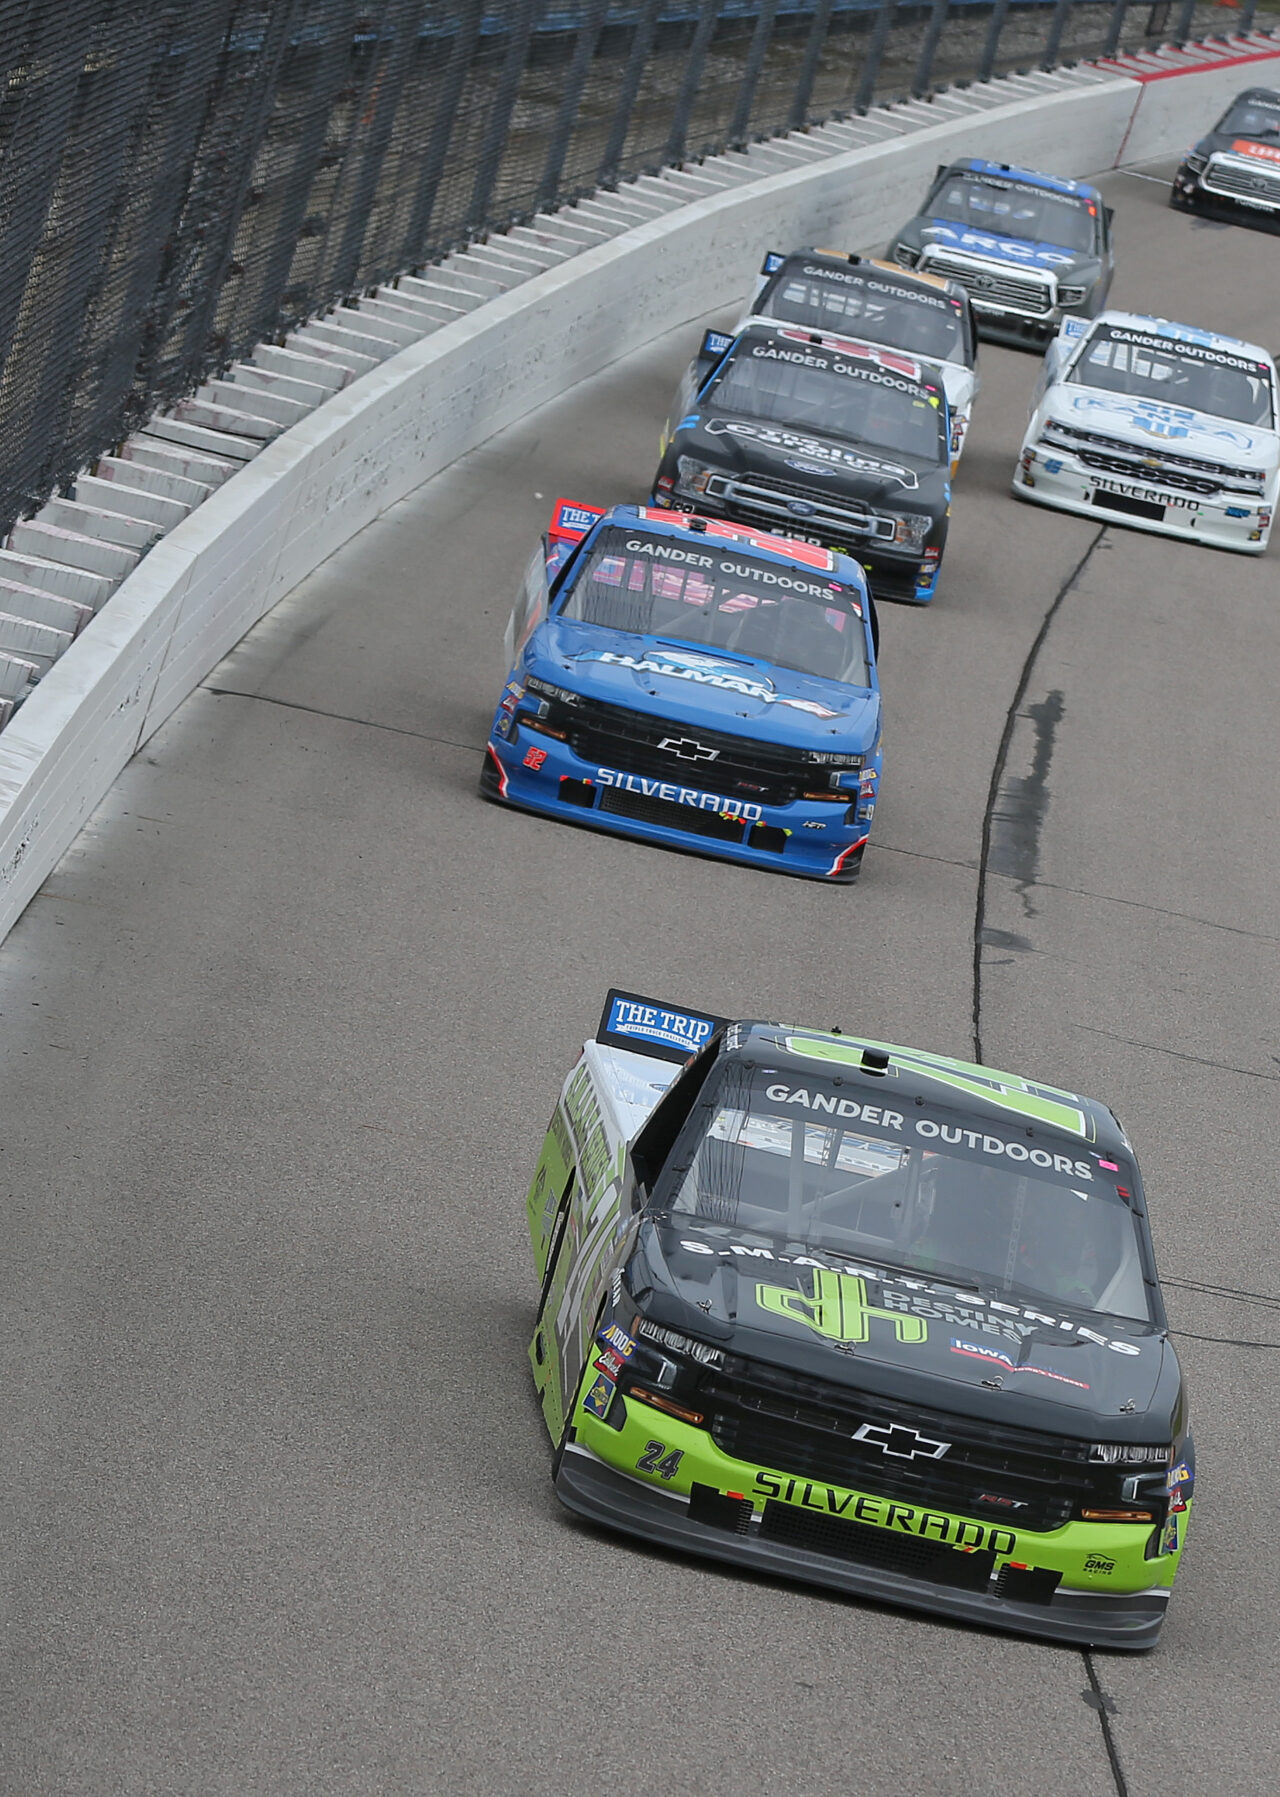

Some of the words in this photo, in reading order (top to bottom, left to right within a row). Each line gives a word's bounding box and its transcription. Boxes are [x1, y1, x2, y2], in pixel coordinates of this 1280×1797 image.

[921, 226, 1076, 265] ARCO
[803, 265, 864, 286] GANDER
[867, 281, 946, 310] OUTDOORS
[1110, 330, 1174, 351] GANDER
[1174, 344, 1258, 372] OUTDOORS
[752, 346, 829, 370] GANDER
[833, 363, 929, 401] OUTDOORS
[562, 506, 590, 523] THE
[1089, 475, 1200, 511] SILVERADO
[626, 540, 714, 569] GANDER
[719, 562, 834, 600] OUTDOORS
[599, 651, 779, 703] HALMAR
[523, 746, 547, 771] 52
[595, 768, 762, 821] SILVERADO
[616, 1000, 658, 1026] THE
[660, 1011, 710, 1042] TRIP
[765, 1084, 905, 1131] GANDER
[915, 1119, 1095, 1181] OUTDOORS
[882, 1289, 1039, 1337] DESTINY
[883, 1300, 1023, 1345] HOMES
[965, 1292, 1141, 1356] SERIES
[955, 1339, 1014, 1366] IOWA
[635, 1439, 685, 1480] 24
[752, 1471, 1017, 1555] SILVERADO
[1082, 1567, 1112, 1576] RACING
[1084, 1559, 1115, 1571] GMS
